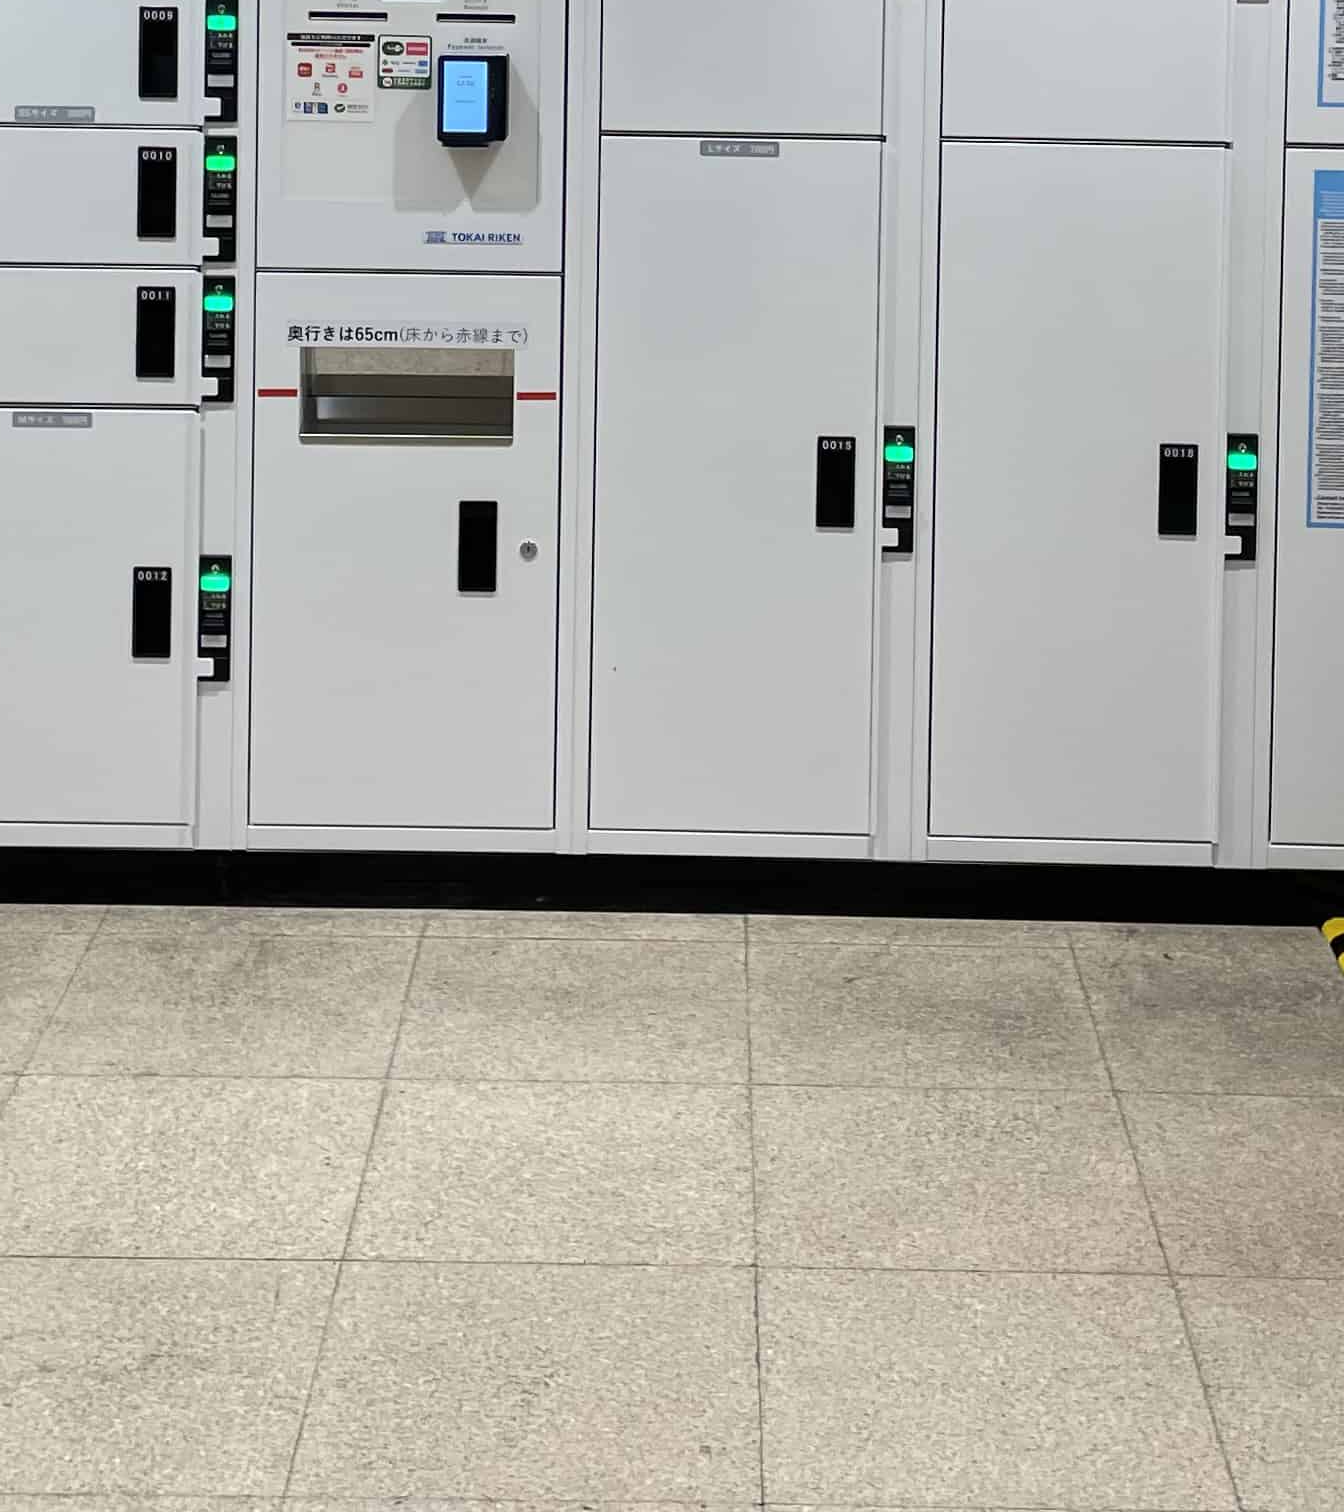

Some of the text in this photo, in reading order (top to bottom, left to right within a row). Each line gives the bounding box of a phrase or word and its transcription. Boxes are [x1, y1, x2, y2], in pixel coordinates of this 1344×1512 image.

[144, 10, 173, 21] 0009
[142, 150, 172, 161] 0010
[452, 232, 521, 242] TOKAI RIKEN
[141, 290, 169, 301] 0011
[822, 440, 851, 450] 0015
[138, 570, 167, 581] 0012
